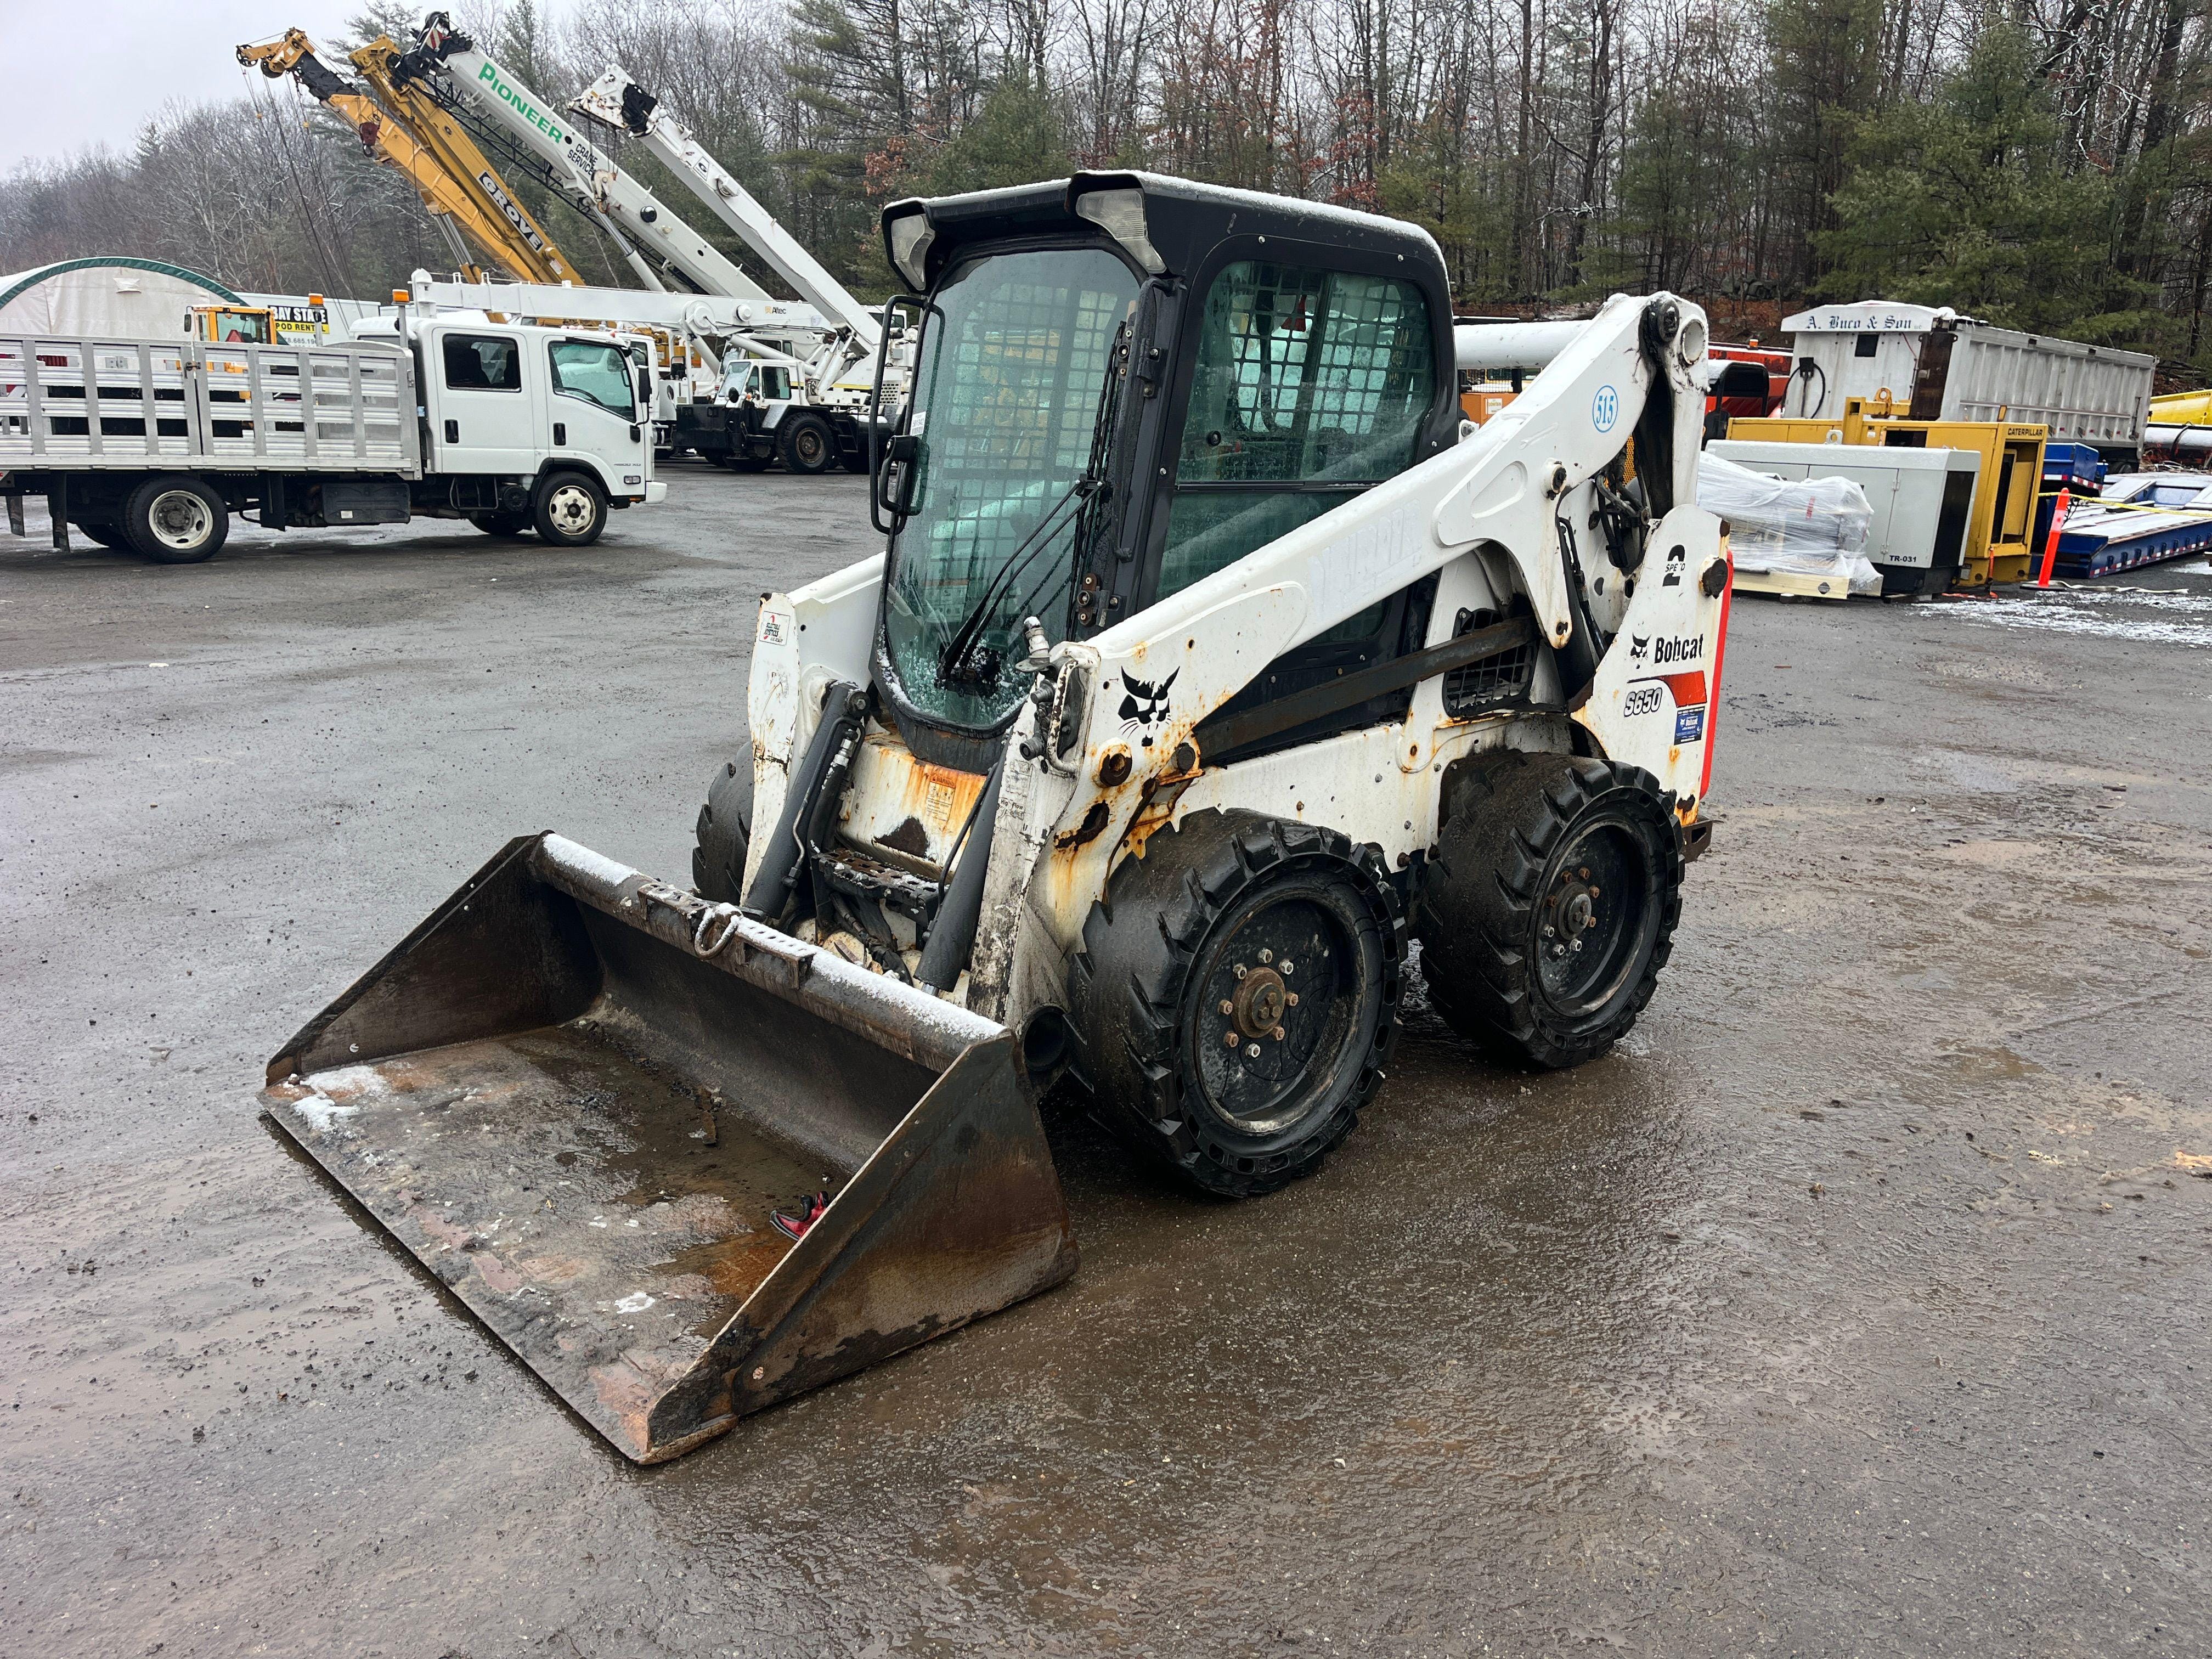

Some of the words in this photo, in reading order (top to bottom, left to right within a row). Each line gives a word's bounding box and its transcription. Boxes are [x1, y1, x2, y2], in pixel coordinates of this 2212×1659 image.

[478, 62, 563, 144] PIONEER
[575, 143, 598, 163] CRANE
[482, 176, 541, 249] GROVE
[270, 306, 291, 320] BAY
[1805, 315, 1821, 329] A.
[1867, 315, 1878, 329] &
[1883, 315, 1912, 329] Son
[1596, 395, 1614, 424] 515
[2008, 428, 2043, 436] CATERPILLAR
[1665, 563, 1685, 572] SPED
[1889, 555, 1917, 563] TR-031
[1654, 633, 1703, 664] Bobcat
[1624, 687, 1663, 718] S650
